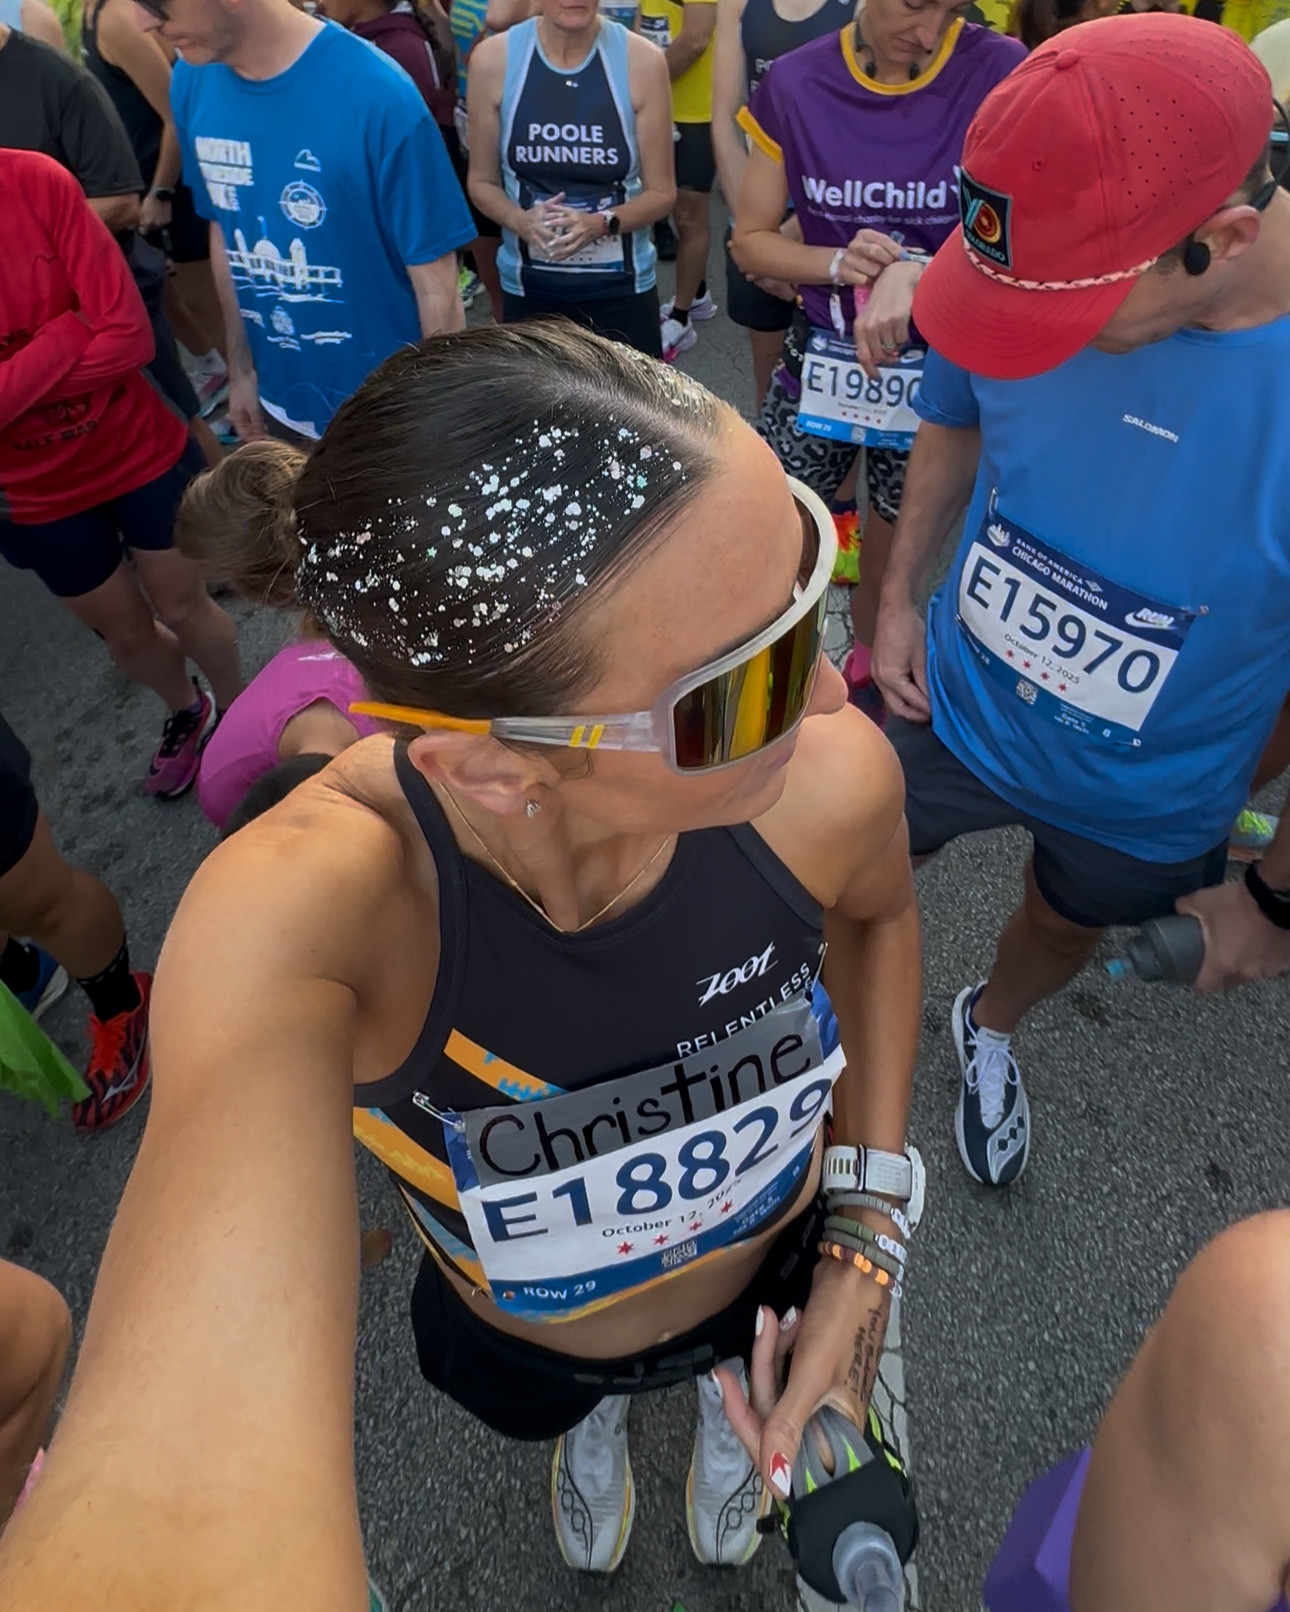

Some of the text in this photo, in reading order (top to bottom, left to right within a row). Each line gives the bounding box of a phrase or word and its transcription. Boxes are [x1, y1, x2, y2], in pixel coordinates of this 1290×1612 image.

[528, 123, 604, 143] POOLE
[515, 145, 619, 165] RUNNERS
[801, 174, 946, 209] WellChild
[1122, 413, 1179, 443] SALOMON
[1011, 546, 1108, 611] CHICAGO MARATHON
[1016, 537, 1084, 585] BANK OF AMERICA
[966, 555, 1160, 693] E15970
[1004, 633, 1039, 659] October
[1056, 665, 1081, 685] 2025
[479, 1034, 811, 1176] Christine
[481, 1078, 833, 1244] E18829
[602, 1218, 673, 1238] October
[523, 1280, 596, 1300] ROW 29
